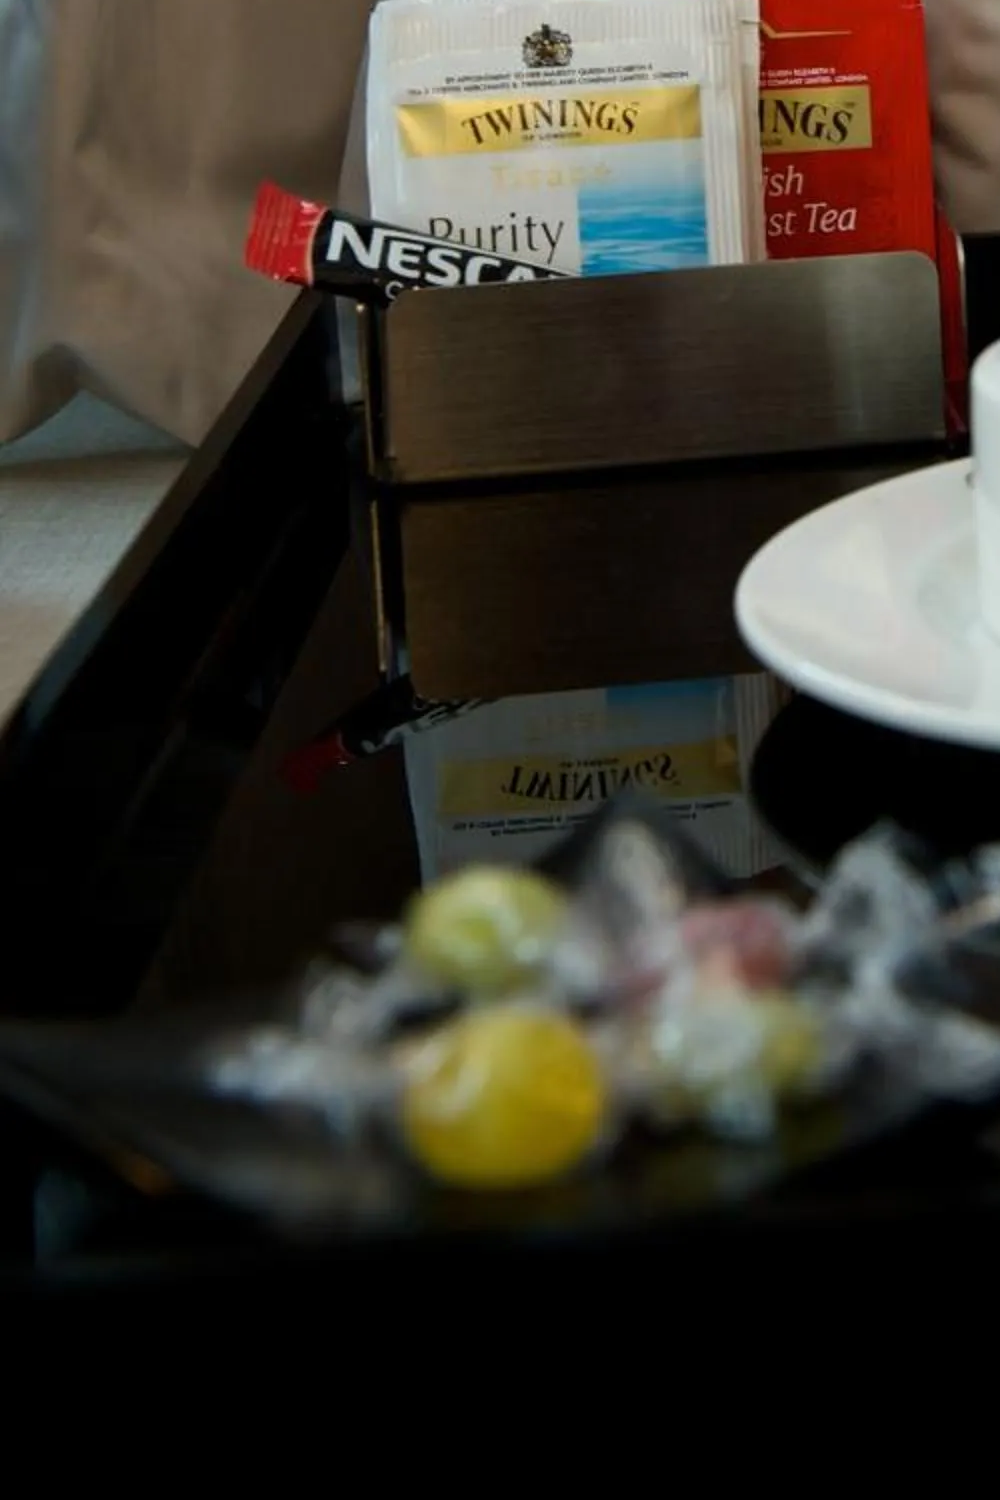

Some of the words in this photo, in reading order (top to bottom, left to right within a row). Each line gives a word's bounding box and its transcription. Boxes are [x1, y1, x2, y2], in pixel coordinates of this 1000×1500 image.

[460, 99, 639, 146] TWININGS
[428, 211, 565, 265] Purity
[803, 201, 858, 234] Tea
[325, 219, 540, 289] NESCA
